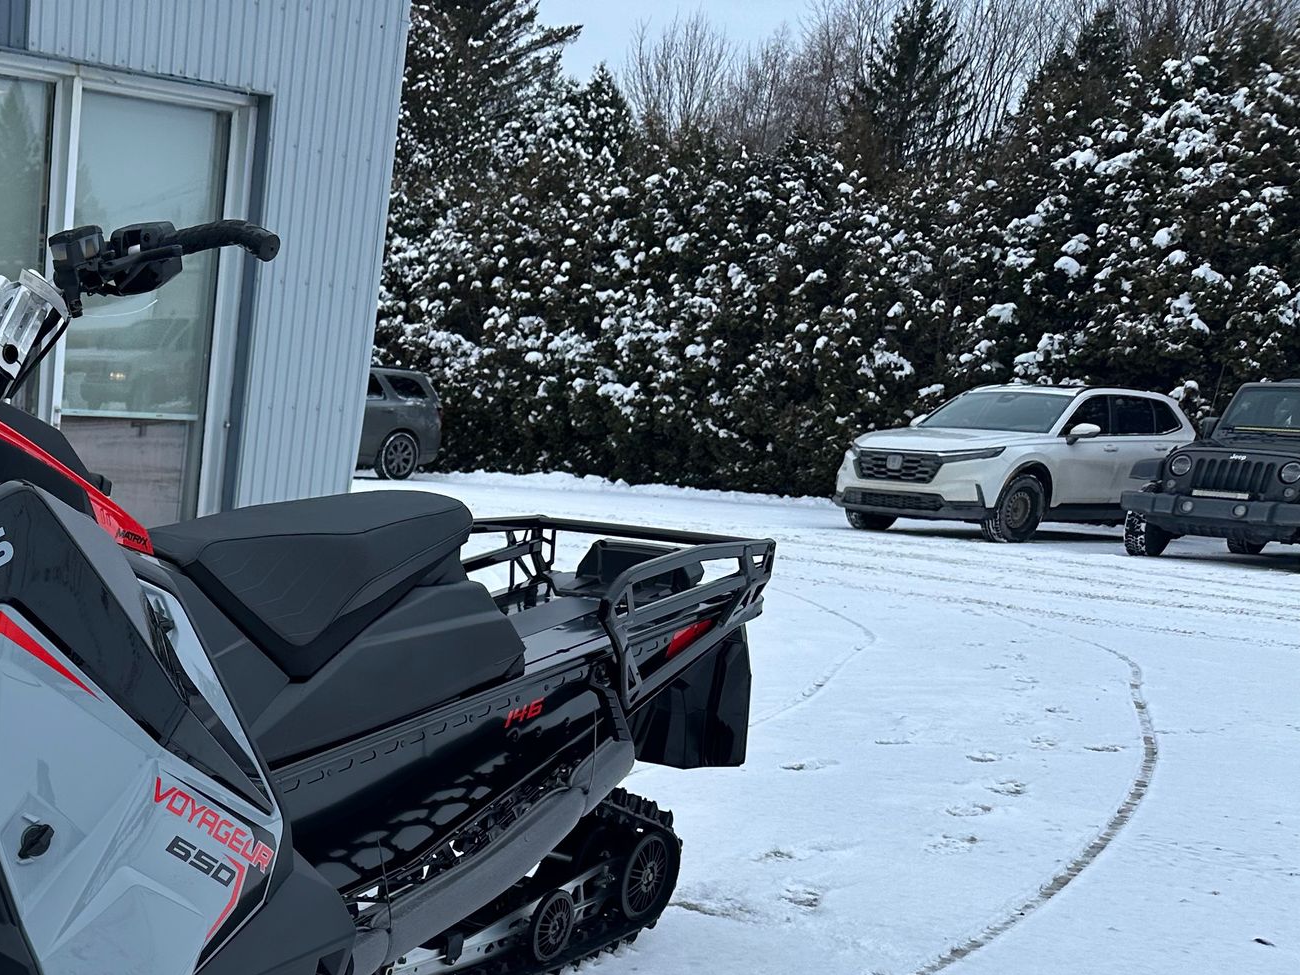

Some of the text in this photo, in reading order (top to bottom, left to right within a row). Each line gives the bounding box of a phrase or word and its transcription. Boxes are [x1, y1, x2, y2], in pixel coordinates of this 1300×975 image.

[504, 697, 546, 728] 146
[153, 776, 275, 874] VOYAGEUR
[165, 835, 236, 887] 650
